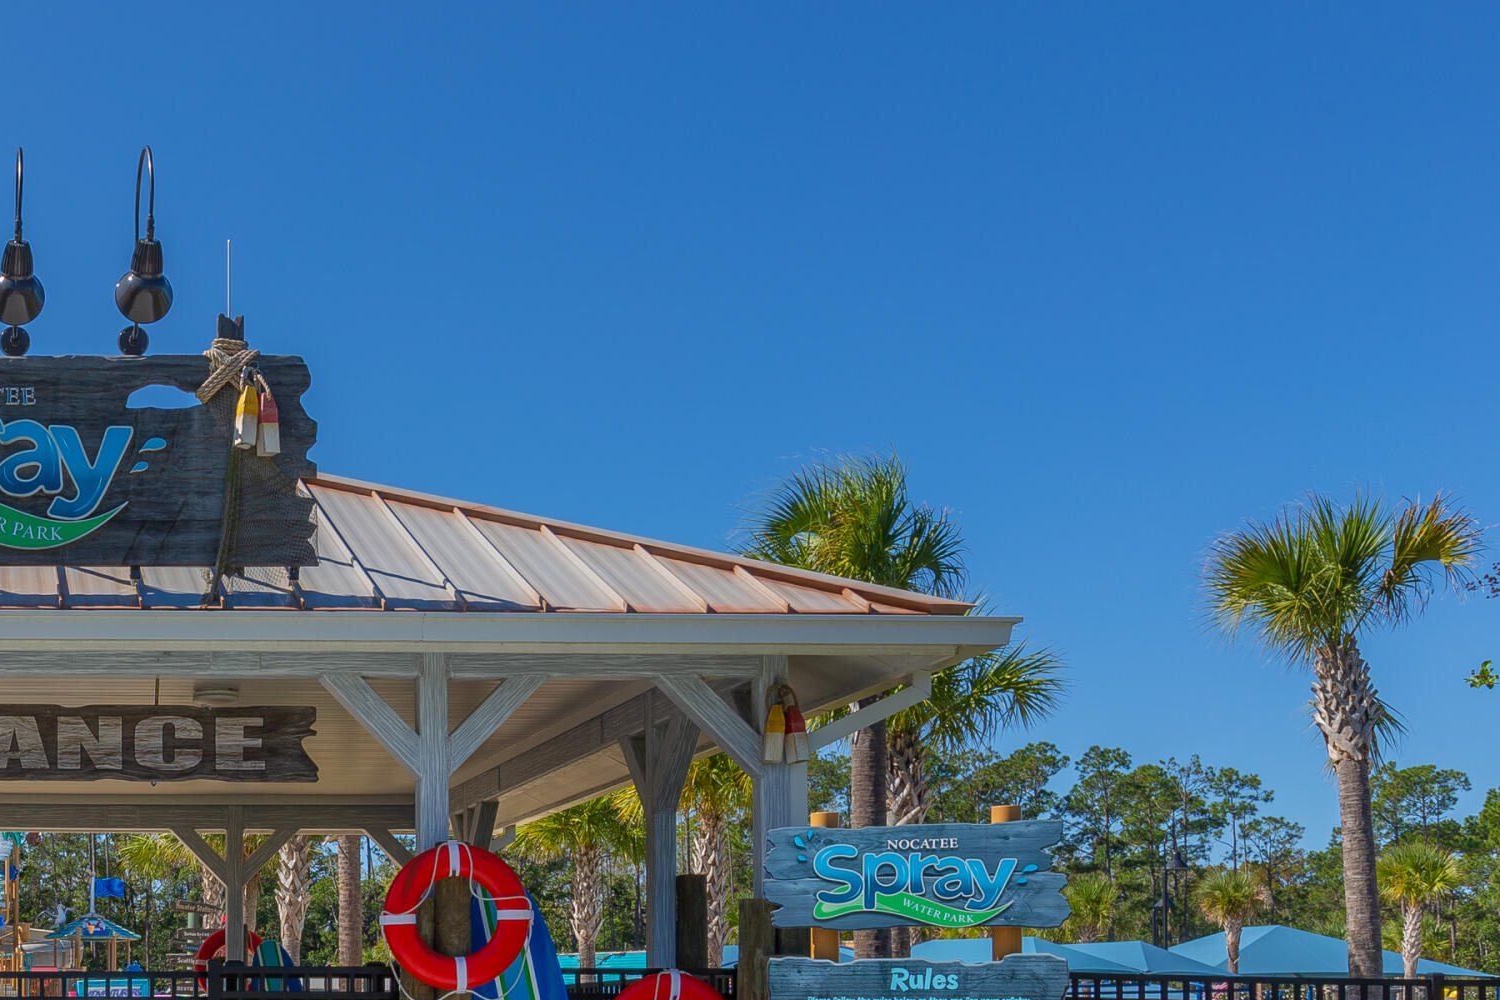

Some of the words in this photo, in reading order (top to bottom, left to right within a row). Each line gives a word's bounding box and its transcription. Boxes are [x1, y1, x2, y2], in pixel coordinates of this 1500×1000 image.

[11, 521, 63, 541] PARK
[887, 838, 959, 850] NOCATEE
[813, 844, 1018, 910] Spray
[903, 897, 941, 919] WATER
[943, 912, 975, 923] PARK
[890, 967, 959, 992] Rules
